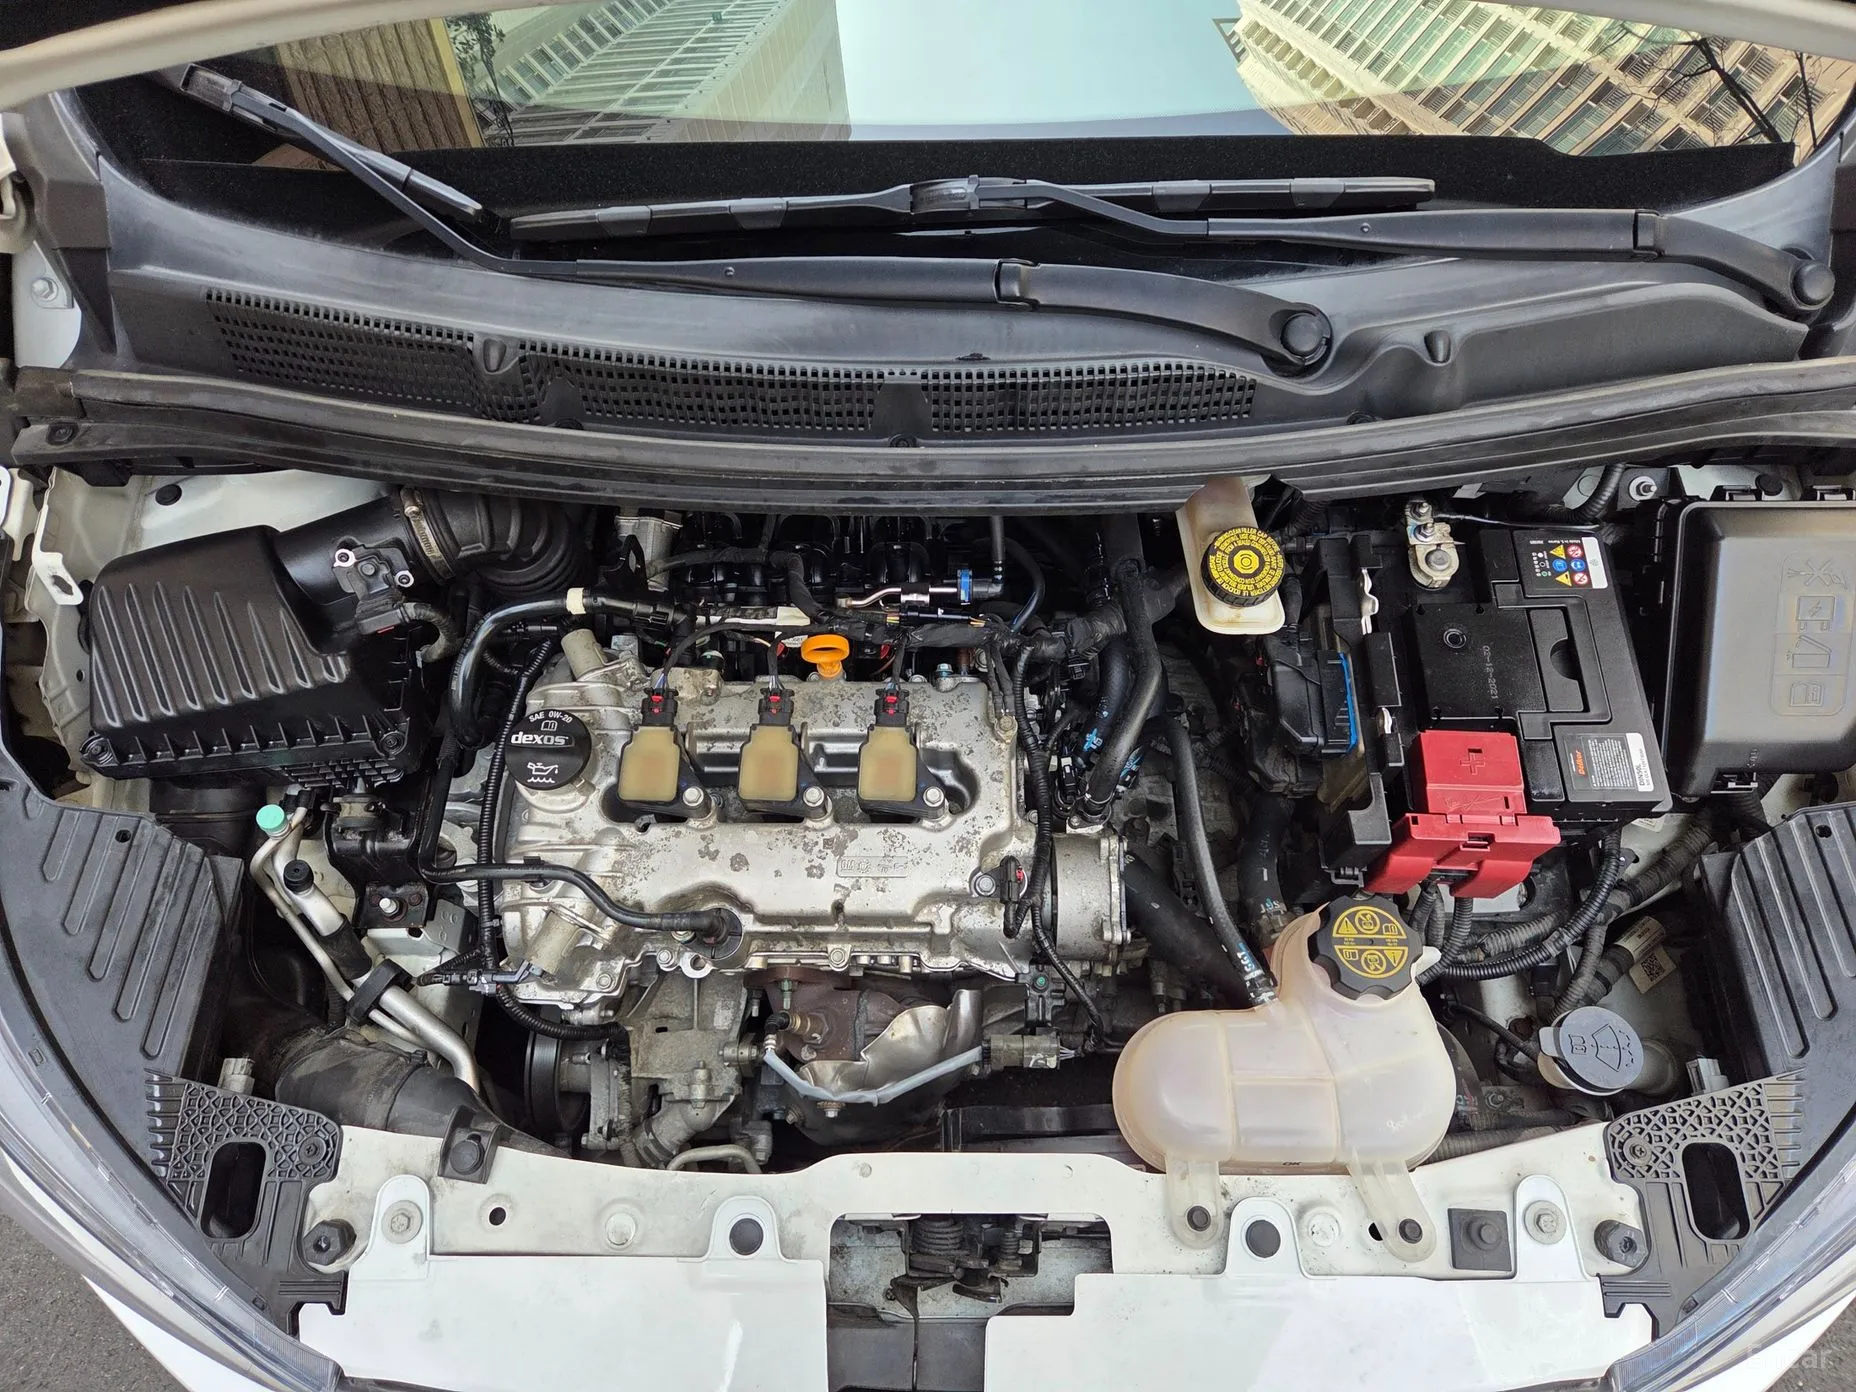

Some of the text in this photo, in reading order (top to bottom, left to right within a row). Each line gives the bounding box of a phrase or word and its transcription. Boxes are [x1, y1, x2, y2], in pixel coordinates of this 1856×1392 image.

[529, 711, 573, 723] SAE 0W-20
[510, 731, 569, 745] dexos
